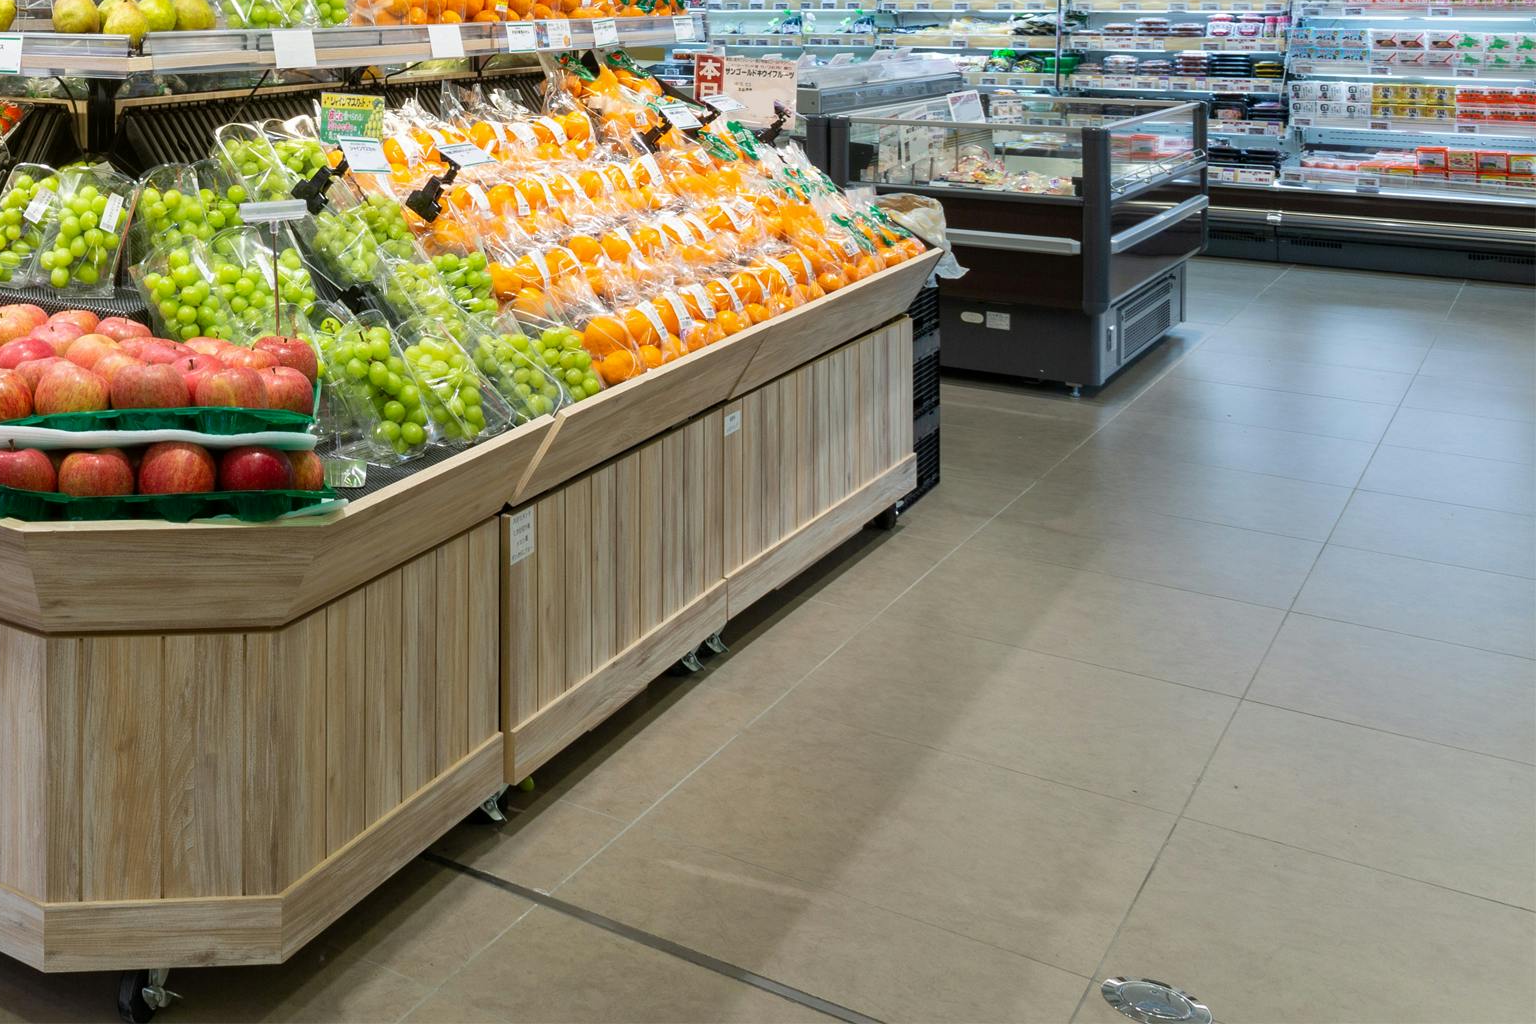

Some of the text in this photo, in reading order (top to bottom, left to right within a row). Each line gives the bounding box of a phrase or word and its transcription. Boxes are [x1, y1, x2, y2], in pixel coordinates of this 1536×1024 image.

[725, 68, 795, 79] サンゴールドキウイフルーツ
